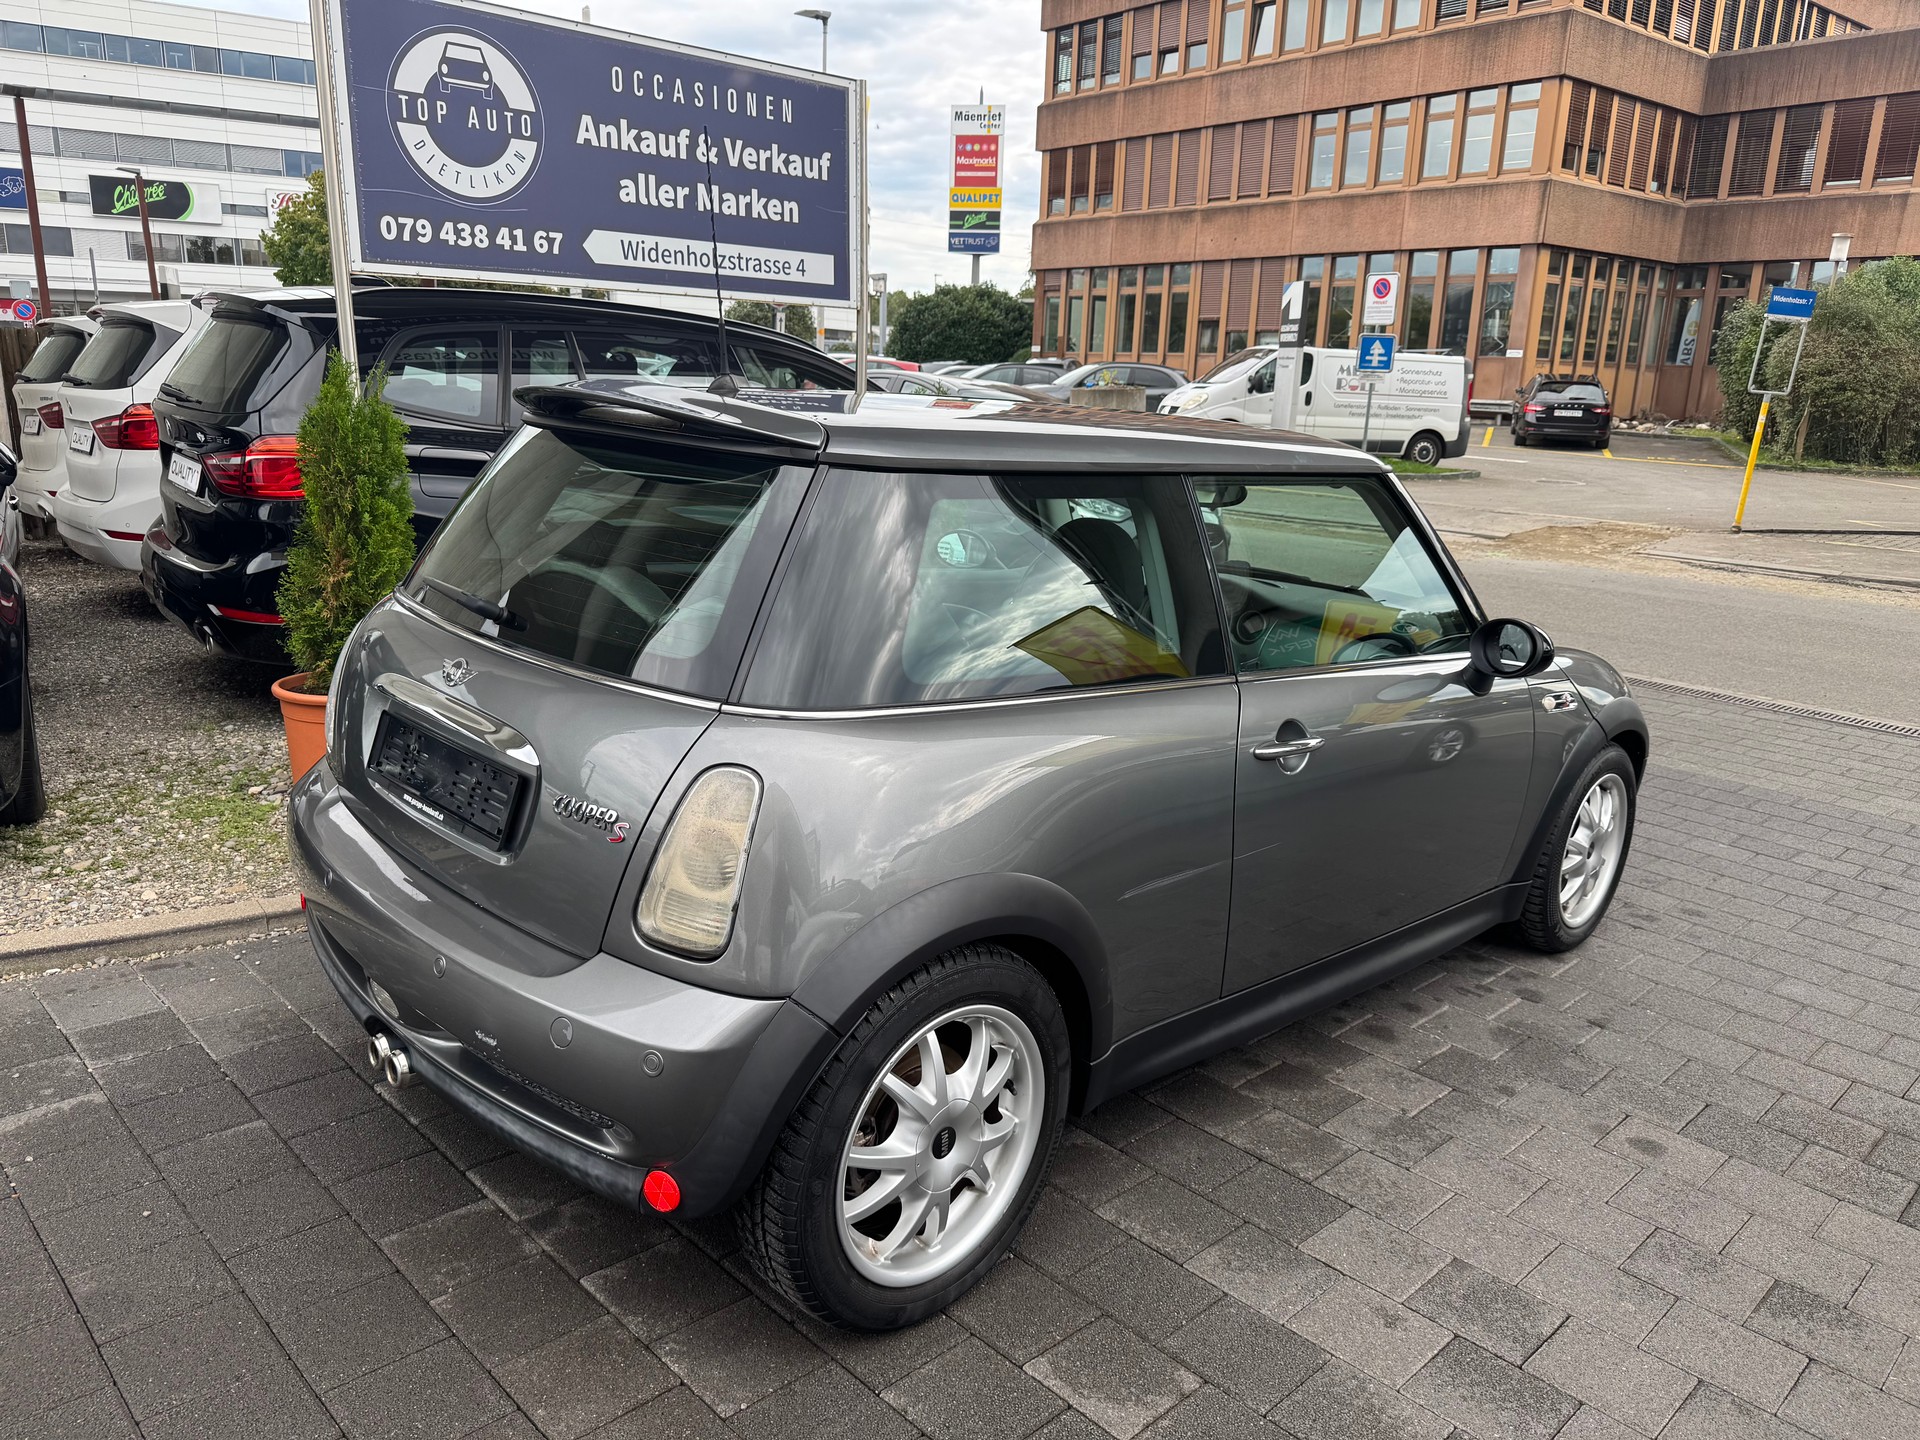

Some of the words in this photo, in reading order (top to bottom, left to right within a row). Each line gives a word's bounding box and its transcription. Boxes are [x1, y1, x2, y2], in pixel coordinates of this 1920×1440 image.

[611, 65, 794, 125] OCCASIONEN
[398, 93, 448, 125] TOP
[467, 105, 533, 138] AUTO
[954, 110, 1002, 122] Mäenriet
[576, 112, 690, 160] Ankauf
[696, 133, 719, 166] &
[723, 136, 832, 183] Verkauf
[956, 155, 996, 166] Maximarkt
[413, 138, 529, 190] DIETLIKON
[618, 172, 690, 212] aller
[697, 182, 801, 225] Marken
[951, 193, 1000, 203] QUALIPET
[379, 214, 433, 245] 079
[439, 222, 490, 249] 438
[495, 226, 528, 253] 41
[532, 229, 564, 256] 67
[620, 238, 792, 277] Widenholzstrasse
[795, 257, 807, 278] 4
[1773, 294, 1808, 305] Widenholzstr.
[1400, 367, 1443, 377] Sonnenschutz
[1398, 387, 1448, 397] Montageservice
[552, 794, 620, 824] COOPER
[940, 1129, 949, 1156] MINI
